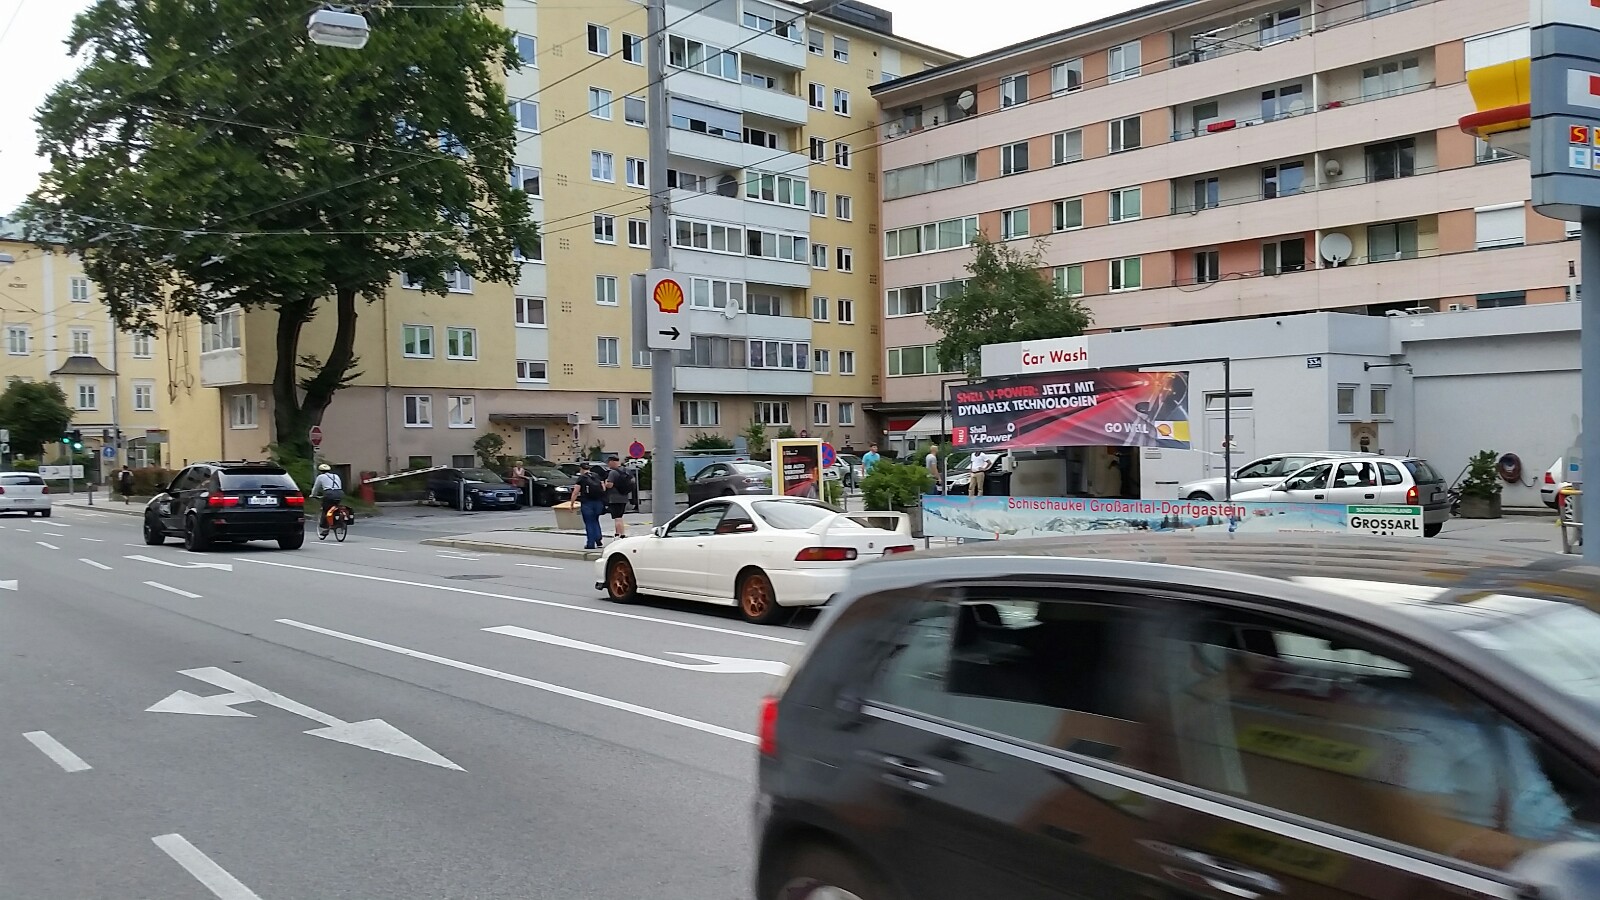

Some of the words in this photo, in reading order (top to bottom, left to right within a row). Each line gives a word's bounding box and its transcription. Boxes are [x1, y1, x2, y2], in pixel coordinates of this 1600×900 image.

[1023, 353, 1045, 365] Car
[1049, 346, 1087, 363] Wash
[957, 391, 986, 403] SHELL
[987, 385, 1039, 401] V-POWER:
[1042, 383, 1071, 396] JETZT
[1075, 381, 1094, 393] MIT
[958, 402, 1011, 416] DYNAFLEX
[970, 425, 987, 434] Shell
[1104, 422, 1123, 433] GO
[1123, 422, 1150, 434] WELL
[970, 433, 1012, 444] V-Power
[1008, 497, 1086, 512] Schischaukel
[1090, 499, 1247, 518] Großarltal-Dorfgastein
[1351, 516, 1420, 530] GROSSARL
